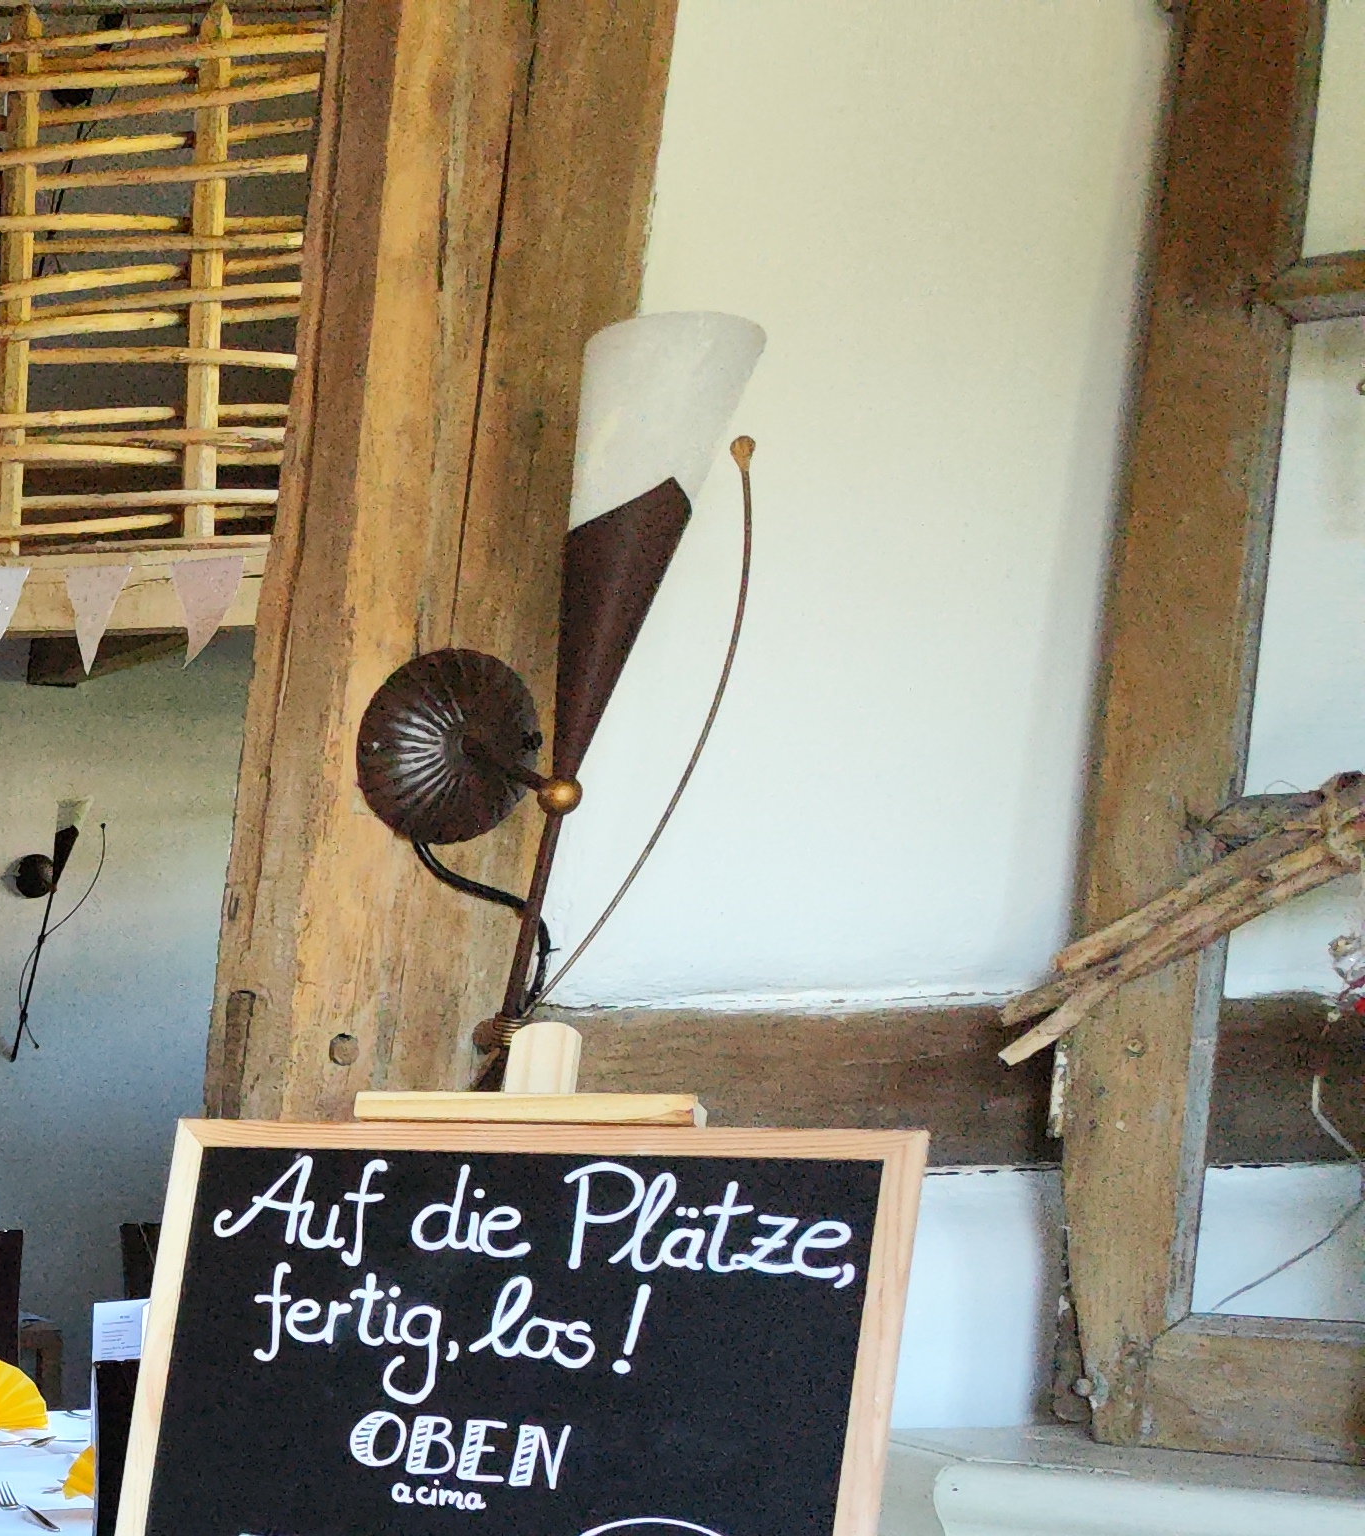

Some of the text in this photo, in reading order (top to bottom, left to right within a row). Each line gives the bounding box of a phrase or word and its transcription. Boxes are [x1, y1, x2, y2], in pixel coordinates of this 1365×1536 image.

[213, 1155, 857, 1289] Auf die Plätze,
[253, 1261, 460, 1405] fertig,
[349, 1410, 572, 1490] OBEN
[391, 1482, 487, 1511] acima
